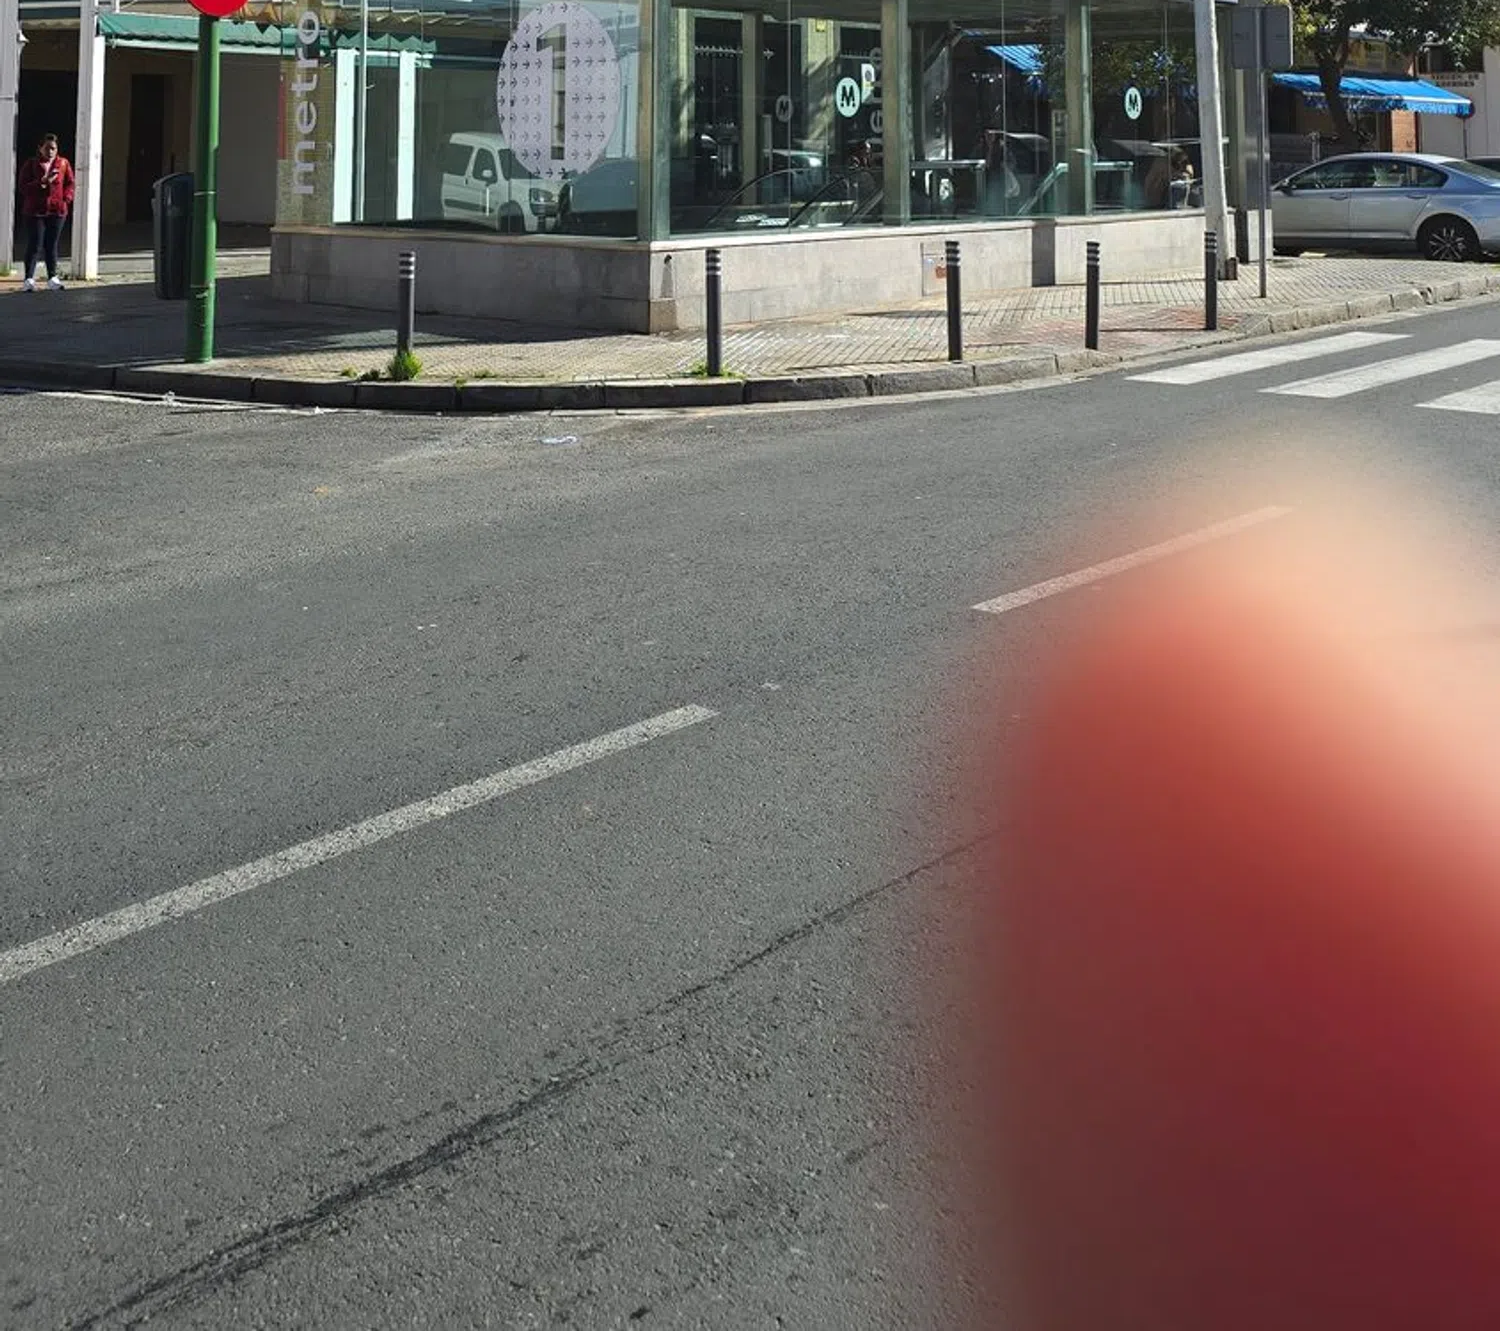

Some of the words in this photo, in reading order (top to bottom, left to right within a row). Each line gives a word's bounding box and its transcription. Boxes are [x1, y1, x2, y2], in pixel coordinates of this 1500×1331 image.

[291, 11, 320, 194] metro
[536, 22, 567, 160] 1
[840, 84, 856, 108] M
